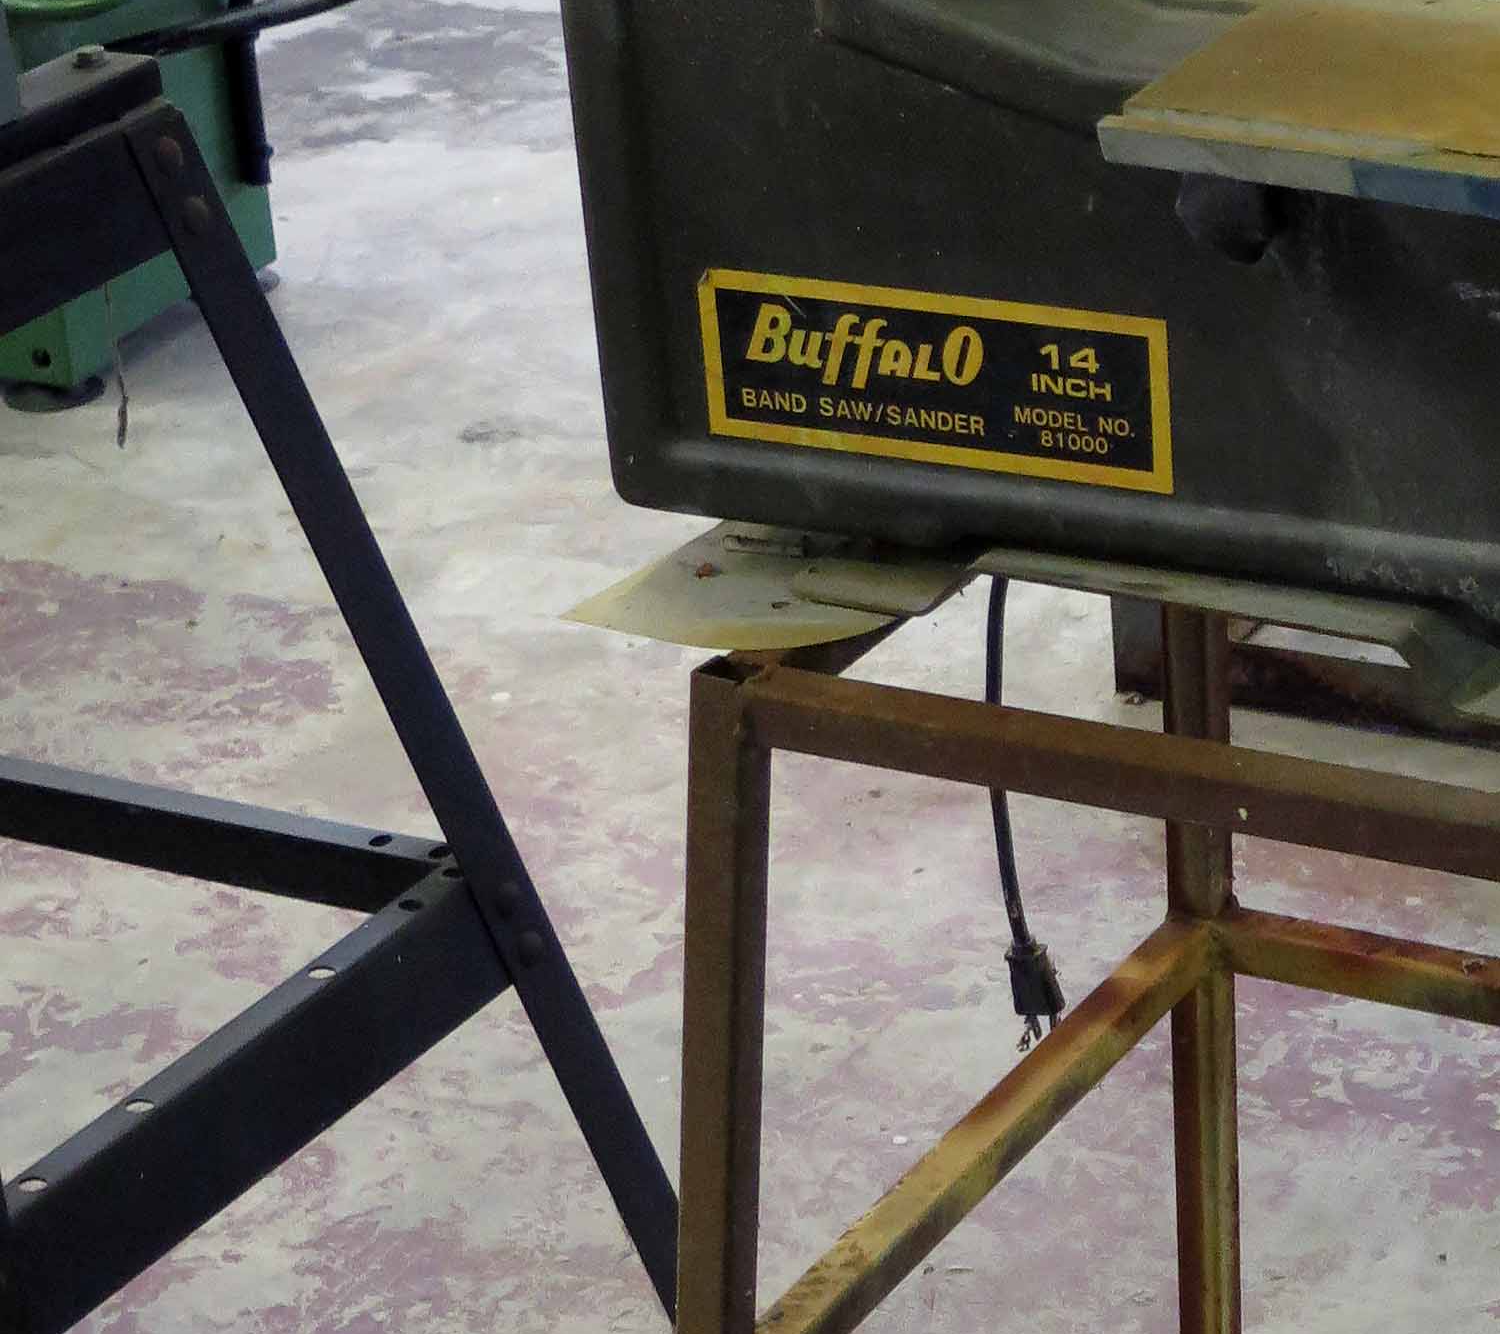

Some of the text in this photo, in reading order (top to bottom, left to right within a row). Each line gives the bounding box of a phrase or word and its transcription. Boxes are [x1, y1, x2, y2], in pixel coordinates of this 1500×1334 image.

[1039, 343, 1100, 374] 14
[1031, 373, 1112, 402] INCH
[742, 387, 985, 436] BAND SAW/SANDER
[1014, 405, 1136, 438] MODEL NO.
[1041, 429, 1108, 455] 81000
